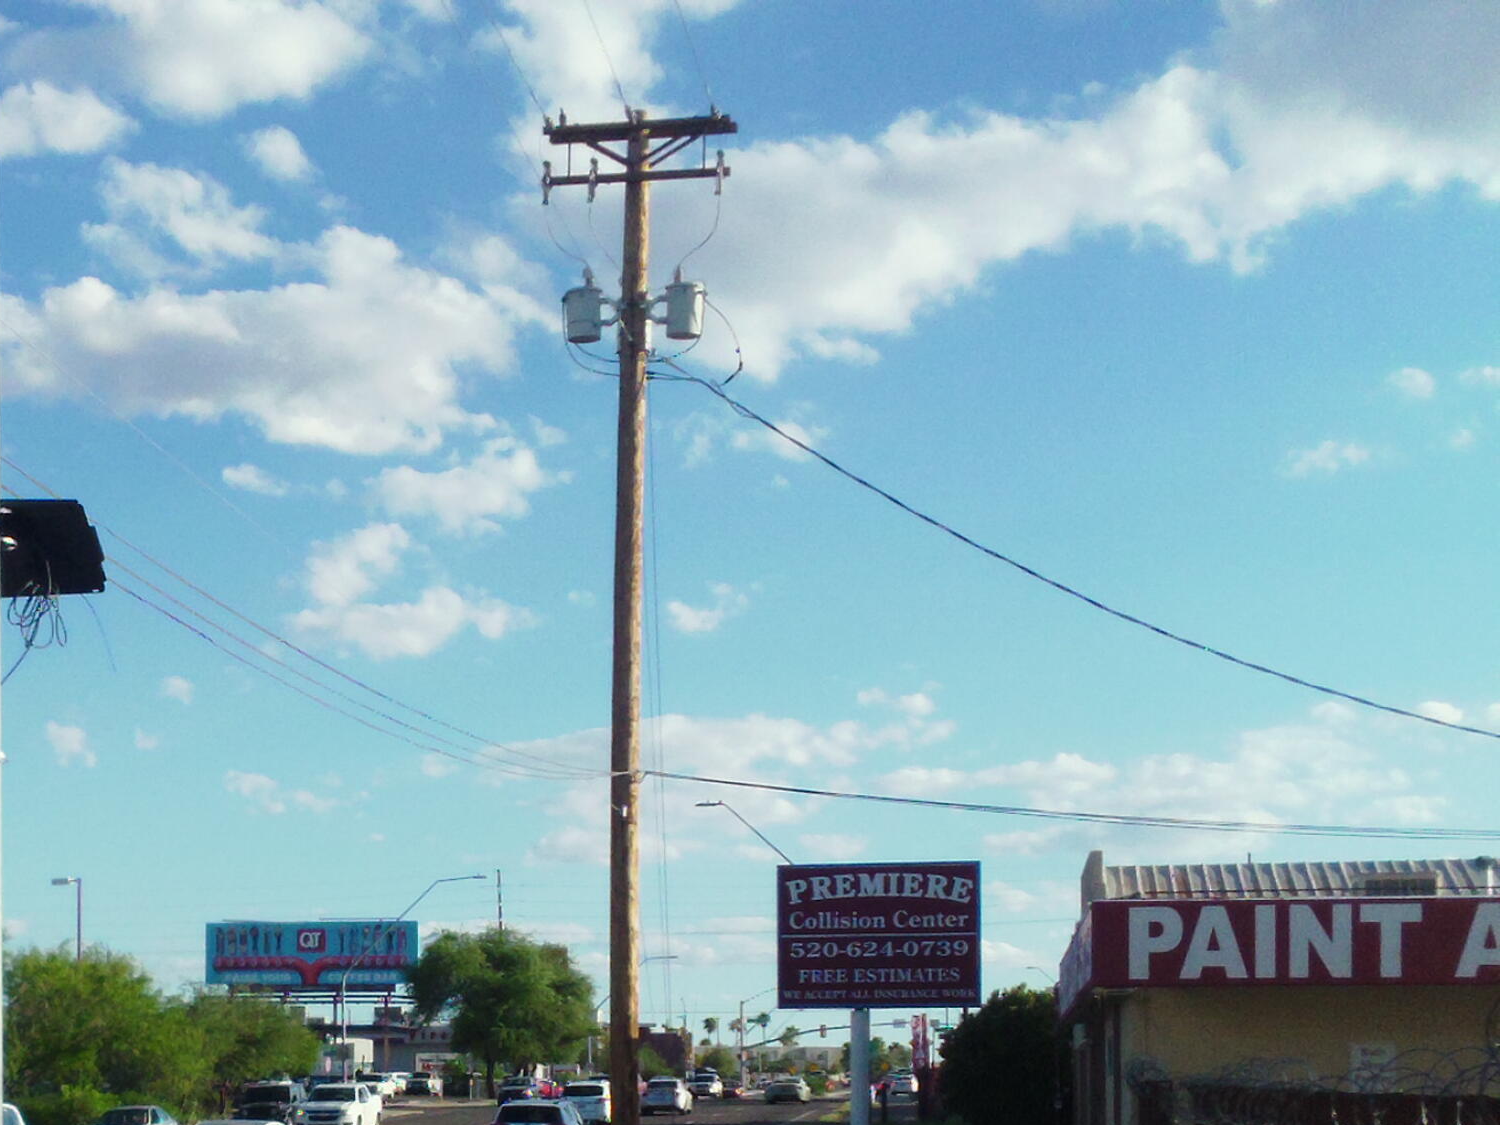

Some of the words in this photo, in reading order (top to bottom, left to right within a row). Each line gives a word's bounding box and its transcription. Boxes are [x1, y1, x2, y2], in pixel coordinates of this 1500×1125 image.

[785, 872, 974, 905] PREMIERE
[789, 910, 886, 930] Collision
[893, 909, 969, 929] Center
[299, 931, 322, 949] QT
[790, 939, 969, 958] 520-624-0739
[1128, 903, 1423, 981] PAINT
[798, 968, 848, 985] FREE
[854, 967, 961, 984] ESTIMATES
[783, 989, 801, 999] WE
[804, 989, 846, 999] ACCEPT
[874, 988, 938, 999] INSURANCE
[942, 988, 976, 998] WORK
